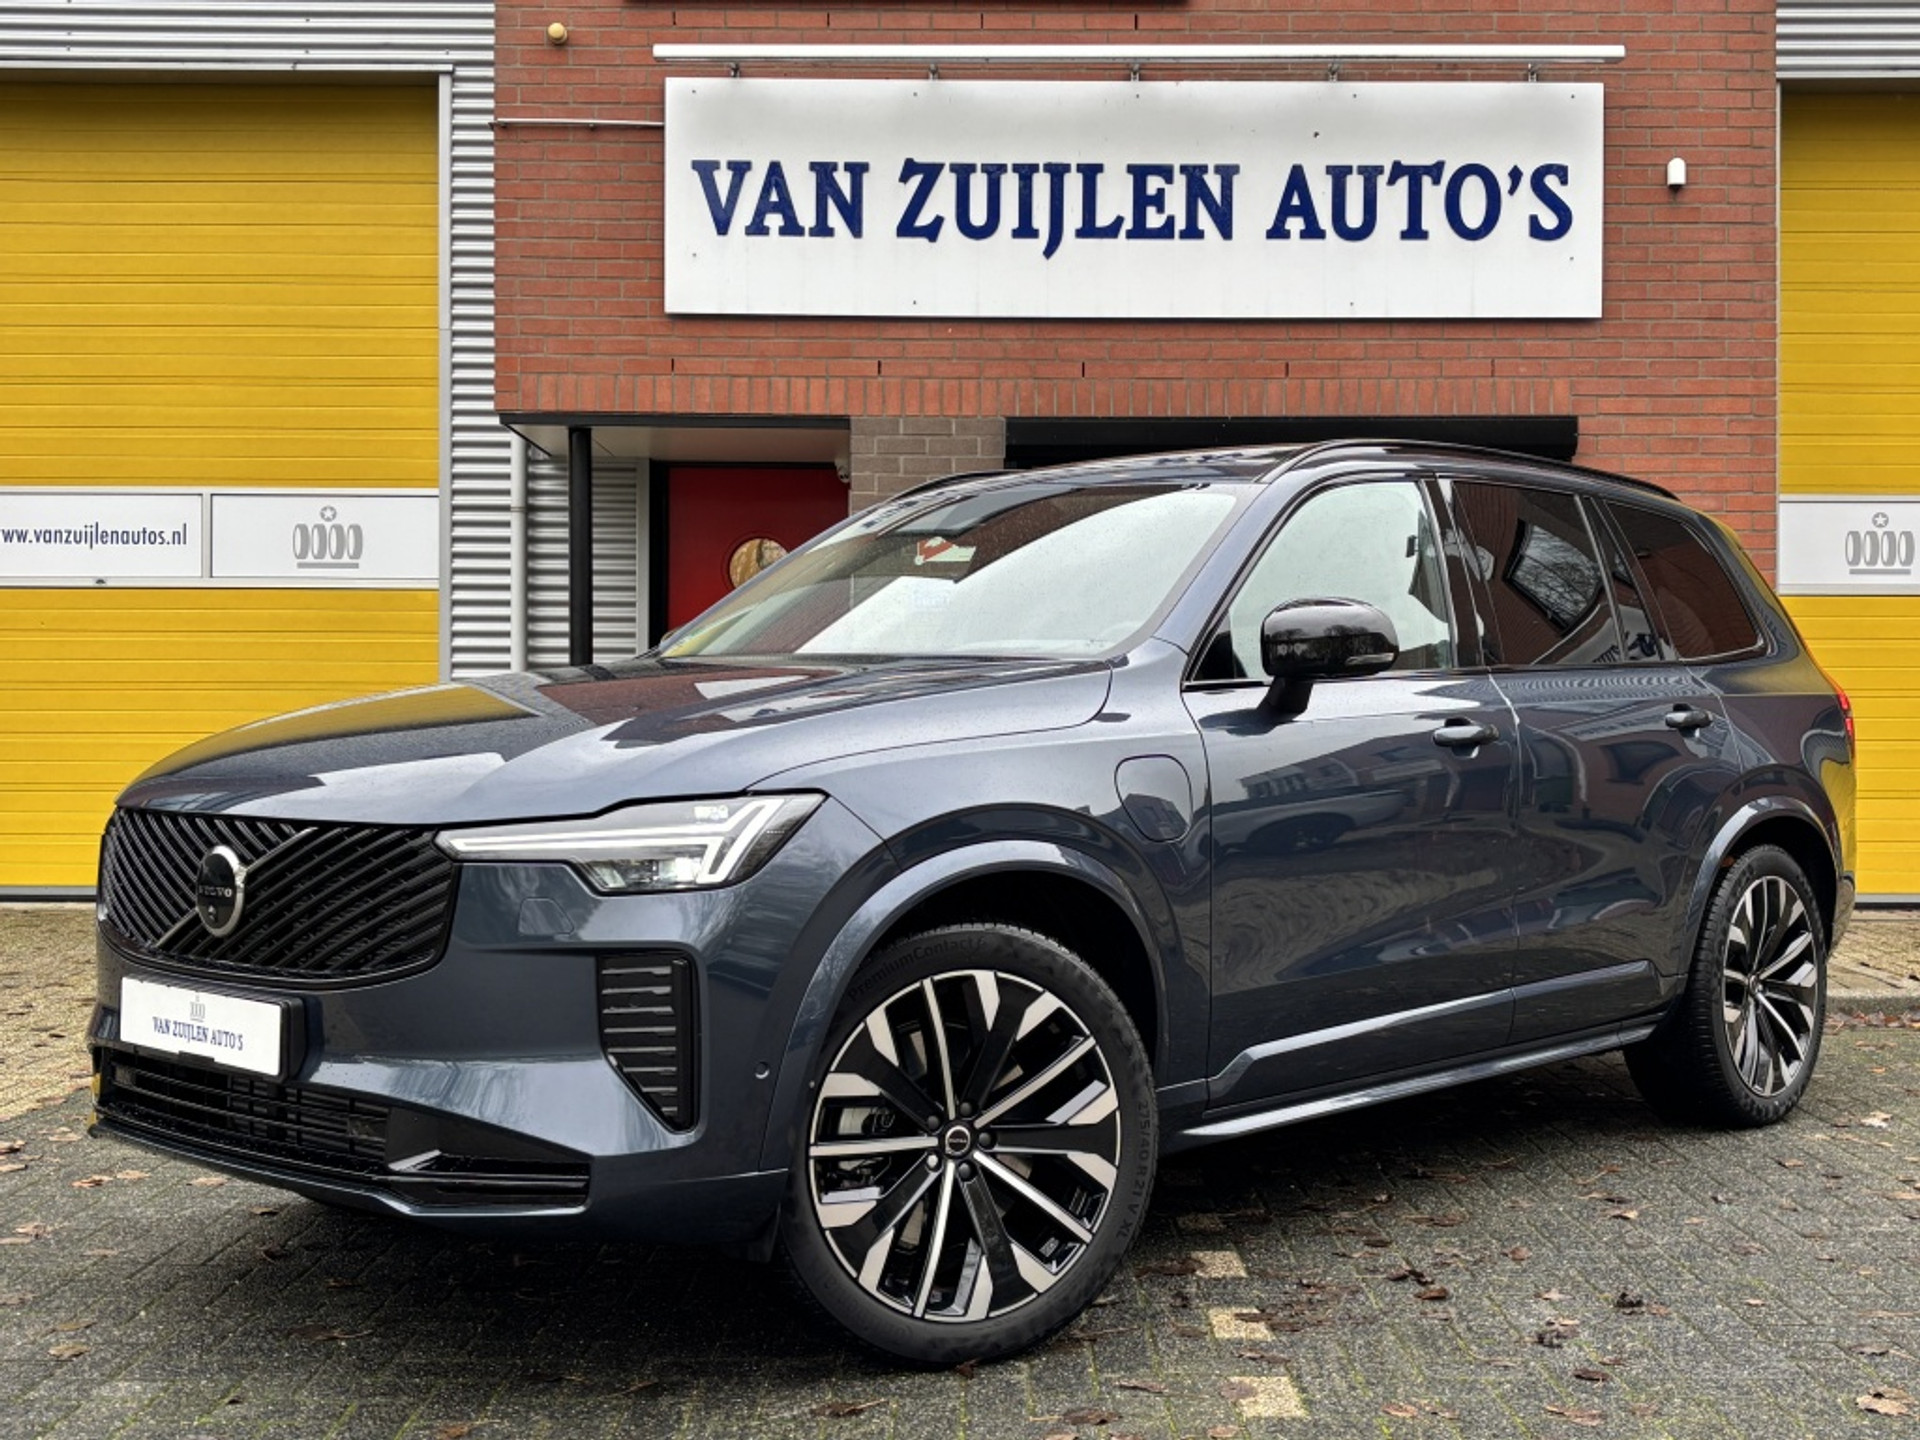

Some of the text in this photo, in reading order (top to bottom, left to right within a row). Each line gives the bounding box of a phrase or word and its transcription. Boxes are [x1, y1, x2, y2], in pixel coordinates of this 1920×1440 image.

[691, 157, 1573, 260] VAN ZUIJLEN AUTO'S
[0, 521, 187, 550] ww.vanzuijlenautos.nl
[152, 1016, 171, 1035] VAN
[172, 1020, 209, 1043] ZUIJLEN
